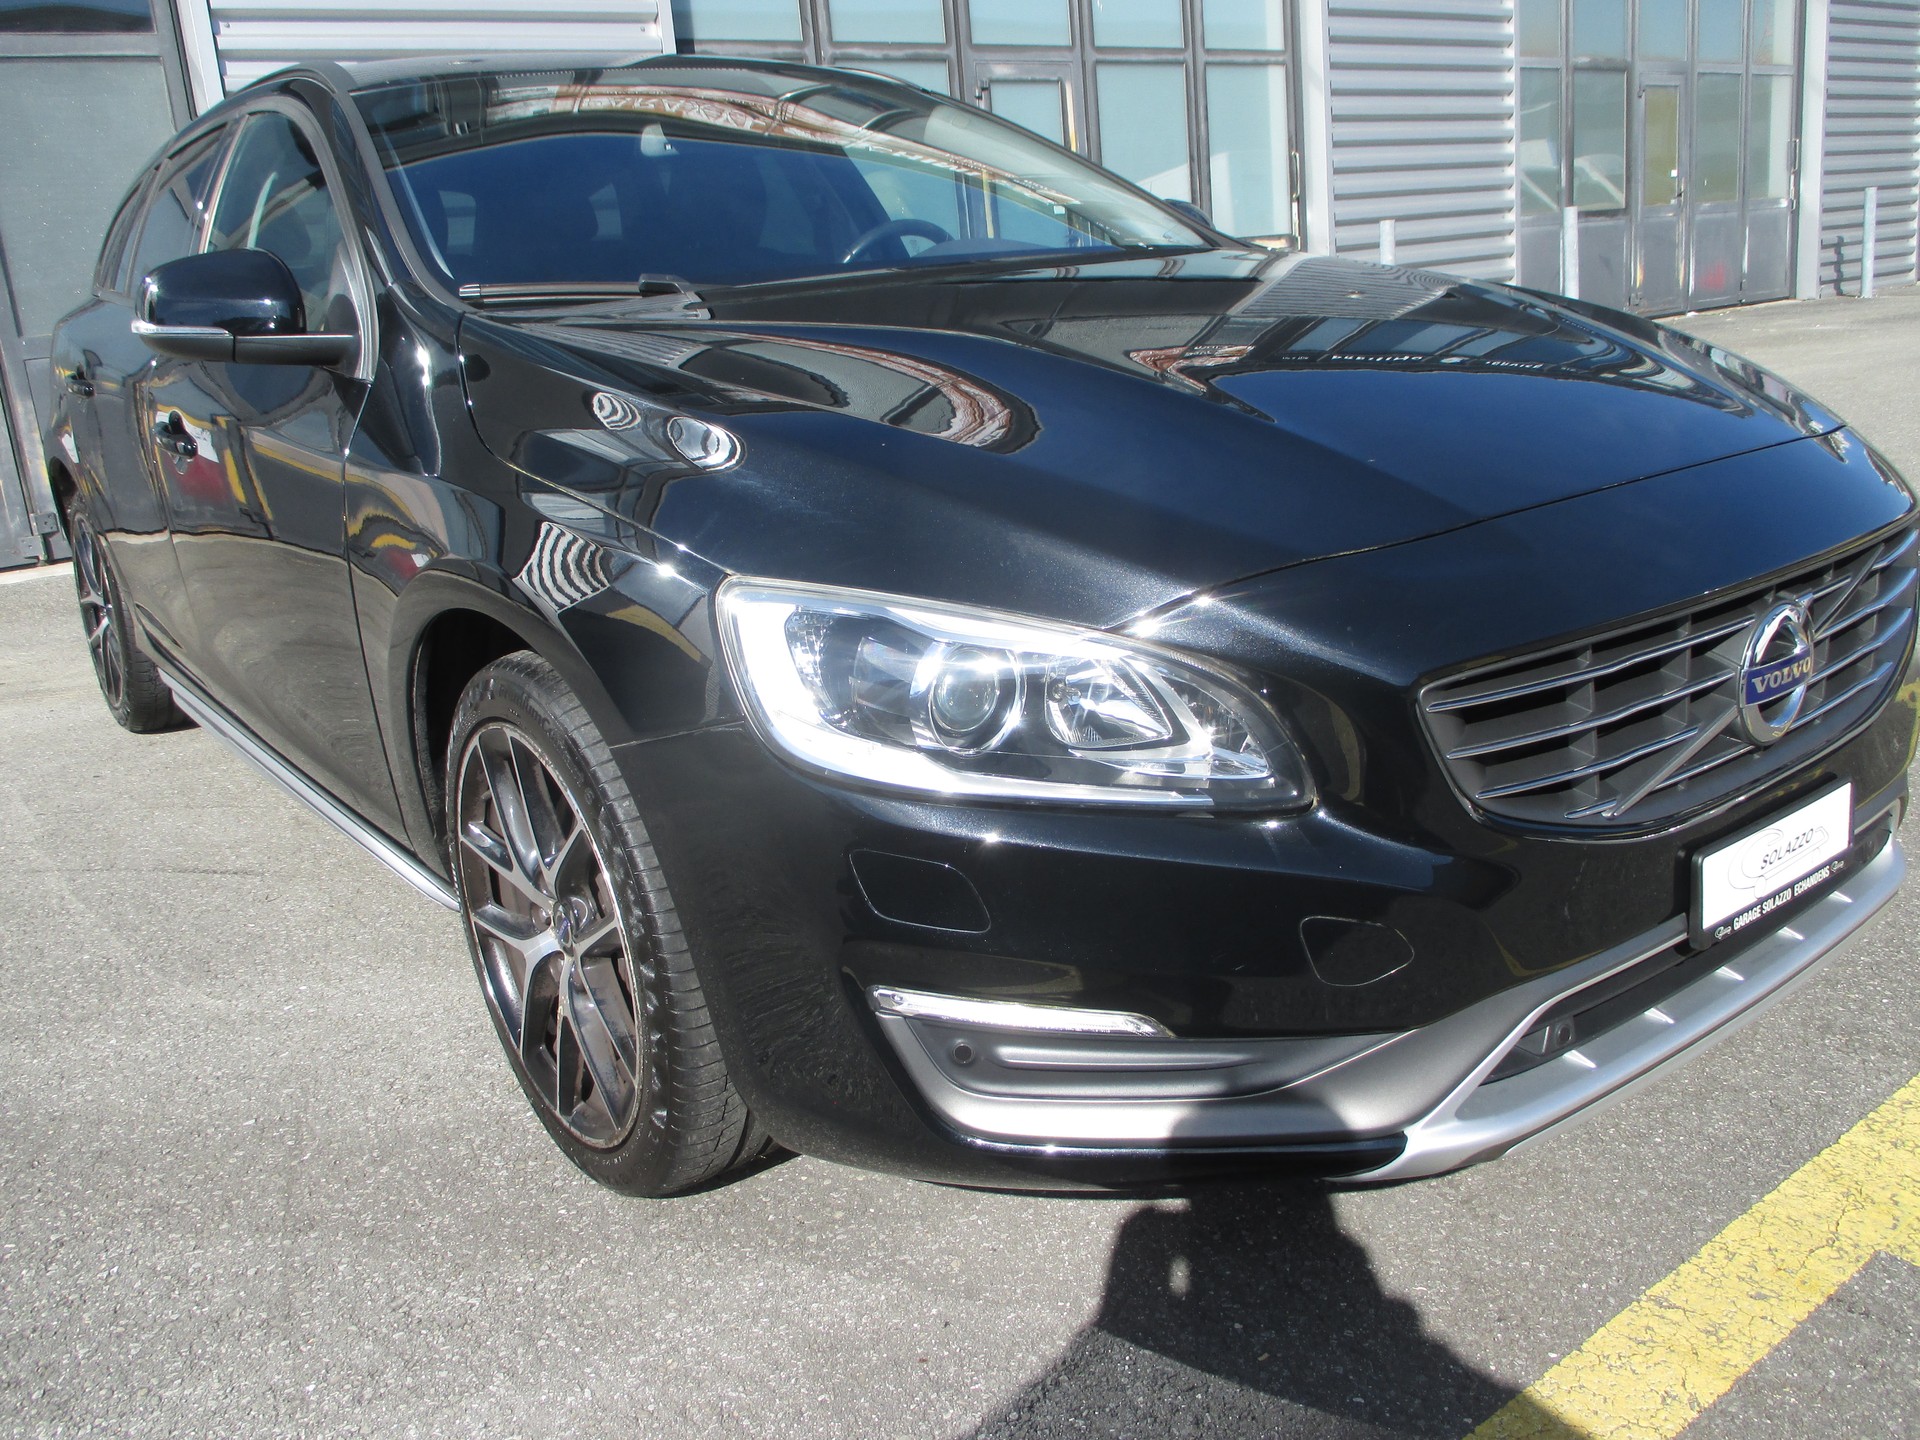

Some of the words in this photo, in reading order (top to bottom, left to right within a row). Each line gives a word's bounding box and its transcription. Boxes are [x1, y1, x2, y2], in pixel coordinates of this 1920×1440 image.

[1752, 656, 1811, 693] VOLVO
[1760, 828, 1814, 870] SOLAZZO
[1733, 906, 1762, 931] GARAGE
[1762, 888, 1792, 914] SOLAZZO
[1794, 865, 1830, 896] ECHANDENS
